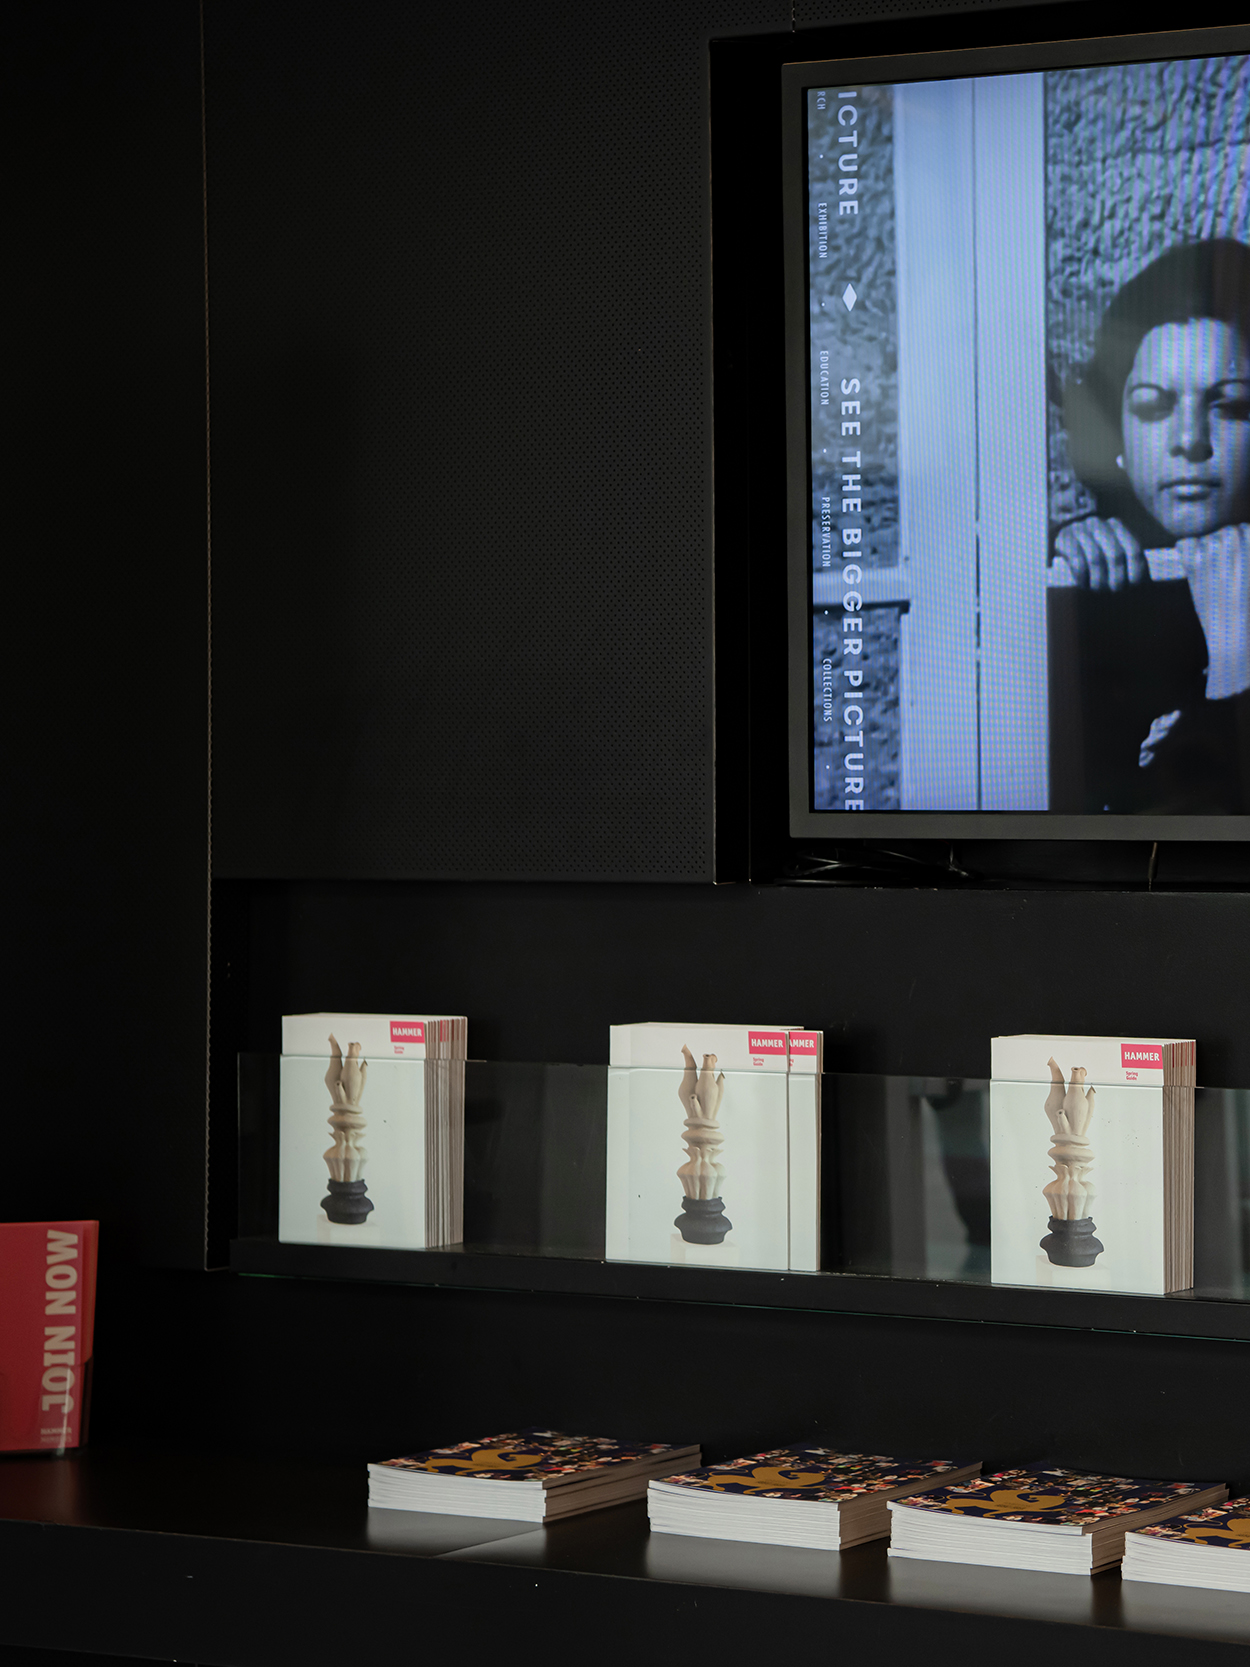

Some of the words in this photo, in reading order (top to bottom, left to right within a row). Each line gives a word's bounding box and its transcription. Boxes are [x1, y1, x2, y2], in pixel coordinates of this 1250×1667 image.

[838, 91, 859, 215] ICTURE
[818, 202, 828, 259] EXHIBITION
[820, 350, 829, 405] EDUCATION
[841, 378, 861, 436] SEE
[841, 451, 862, 513] THE
[822, 497, 831, 567] PRESERVATION
[842, 528, 863, 655] BIGGER
[823, 658, 832, 722] COLLECTIONS
[843, 670, 864, 810] PICTURE
[392, 1027, 422, 1037] HAMMER
[751, 1039, 783, 1048] HAMMER
[789, 1039, 815, 1048] AMMER
[1124, 1052, 1160, 1061] HAMMER
[44, 1229, 78, 1315] NOW
[41, 1326, 76, 1414] JOIN
